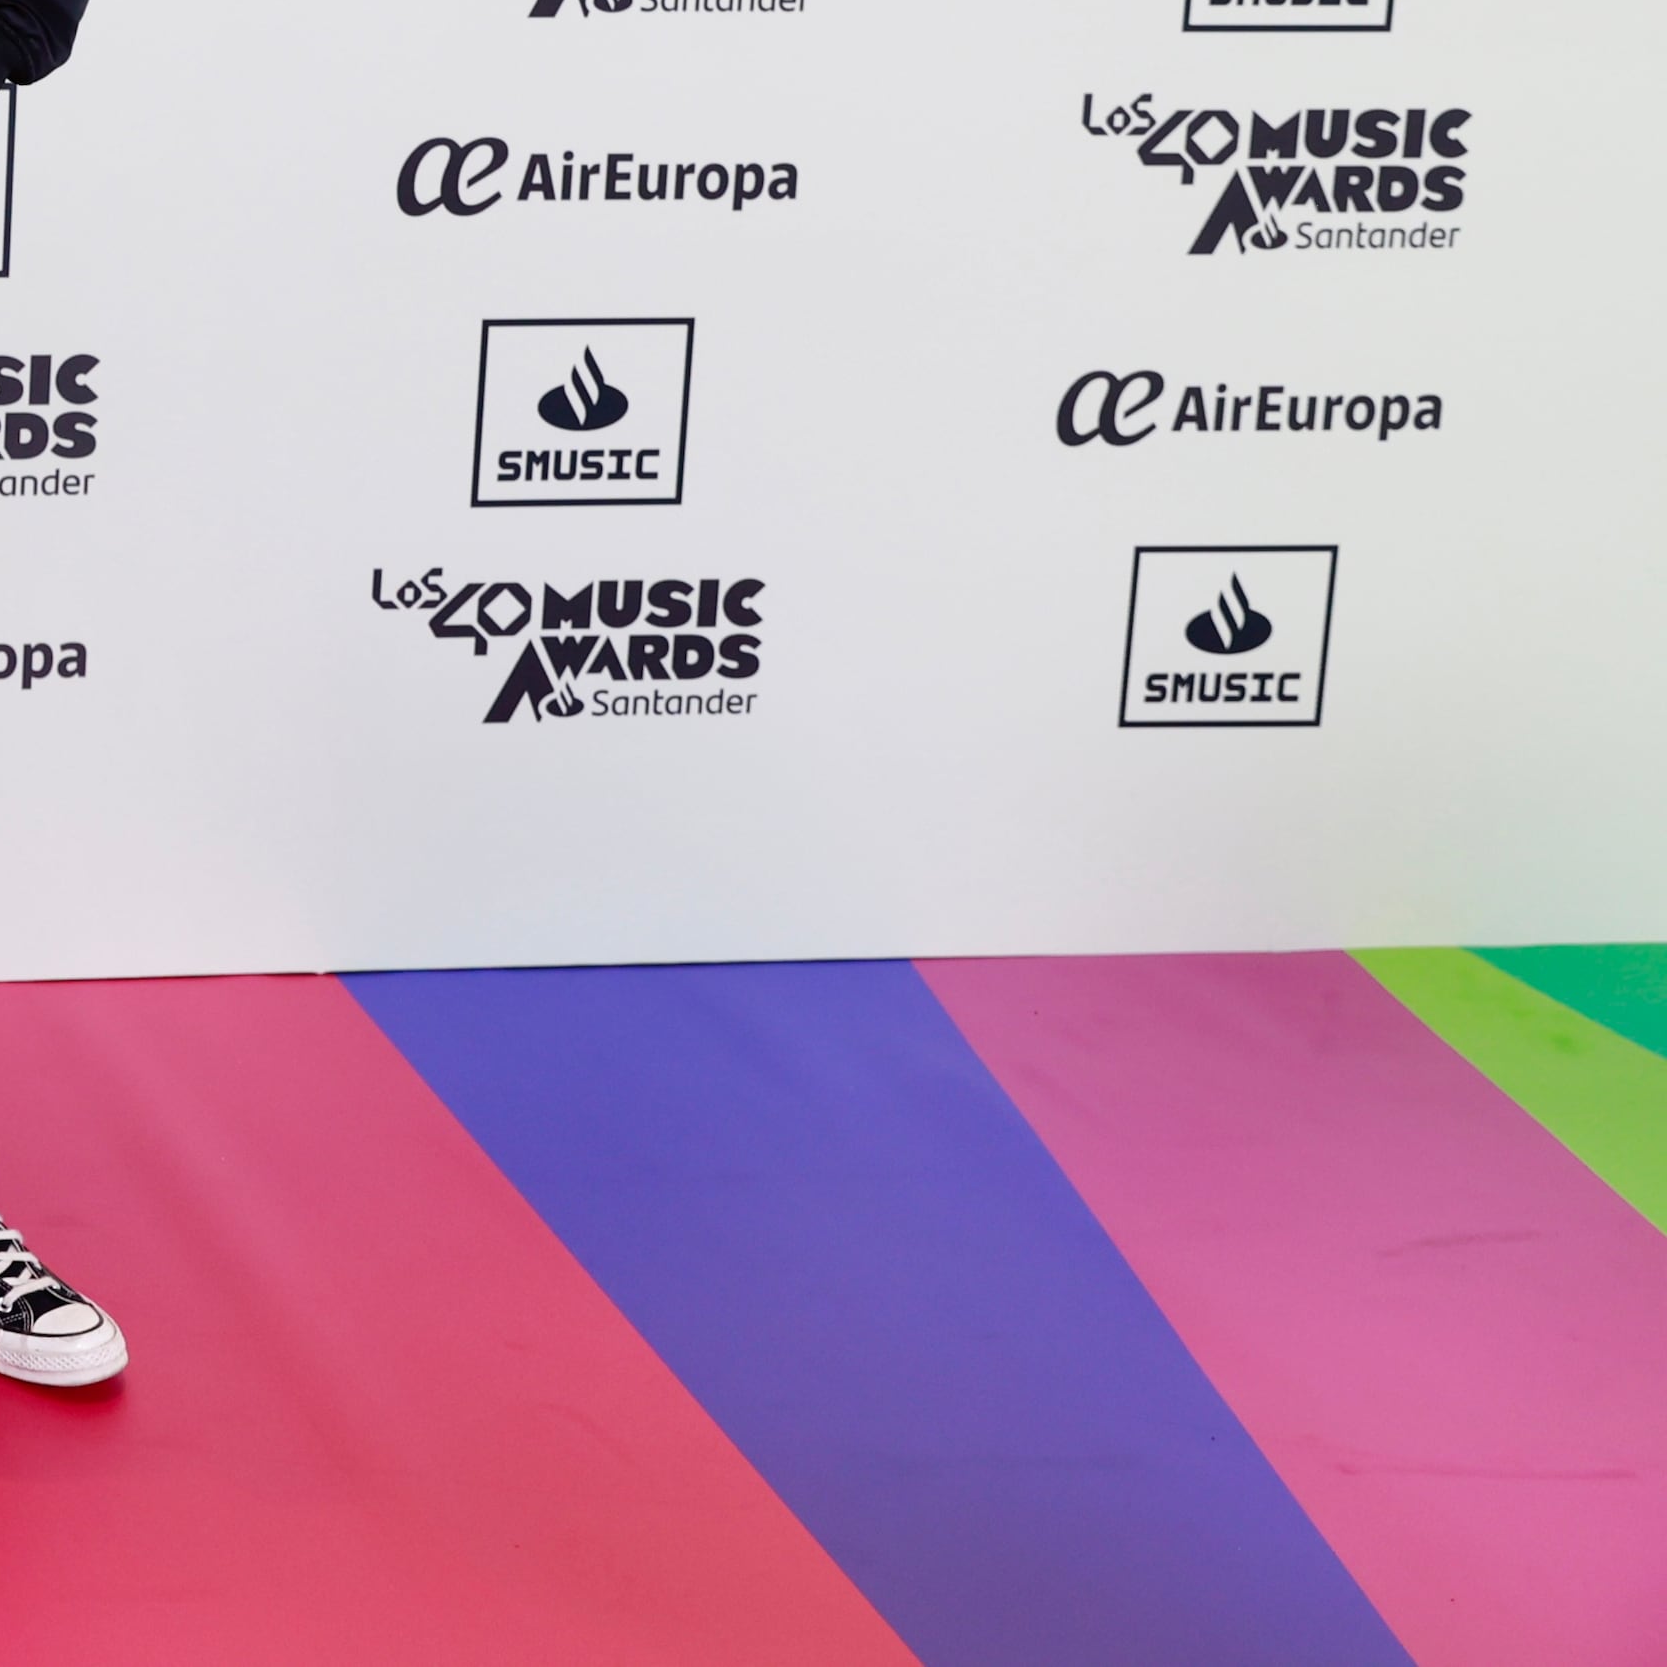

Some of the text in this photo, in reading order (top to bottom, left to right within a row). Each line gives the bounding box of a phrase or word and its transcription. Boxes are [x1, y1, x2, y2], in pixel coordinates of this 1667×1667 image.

[1137, 110, 1240, 185] 40
[1249, 108, 1473, 159] MUSIC
[517, 150, 799, 211] AirEuropa
[1187, 166, 1467, 255] AWARDS
[1295, 221, 1460, 249] Santander
[1172, 384, 1443, 441] AirEuropa
[497, 449, 660, 481] SMUSIC
[429, 582, 532, 656] 40
[541, 578, 766, 630] MUSIC
[483, 634, 762, 724] AWARDS
[591, 688, 758, 716] Santander
[1144, 672, 1301, 703] SMUSIC
